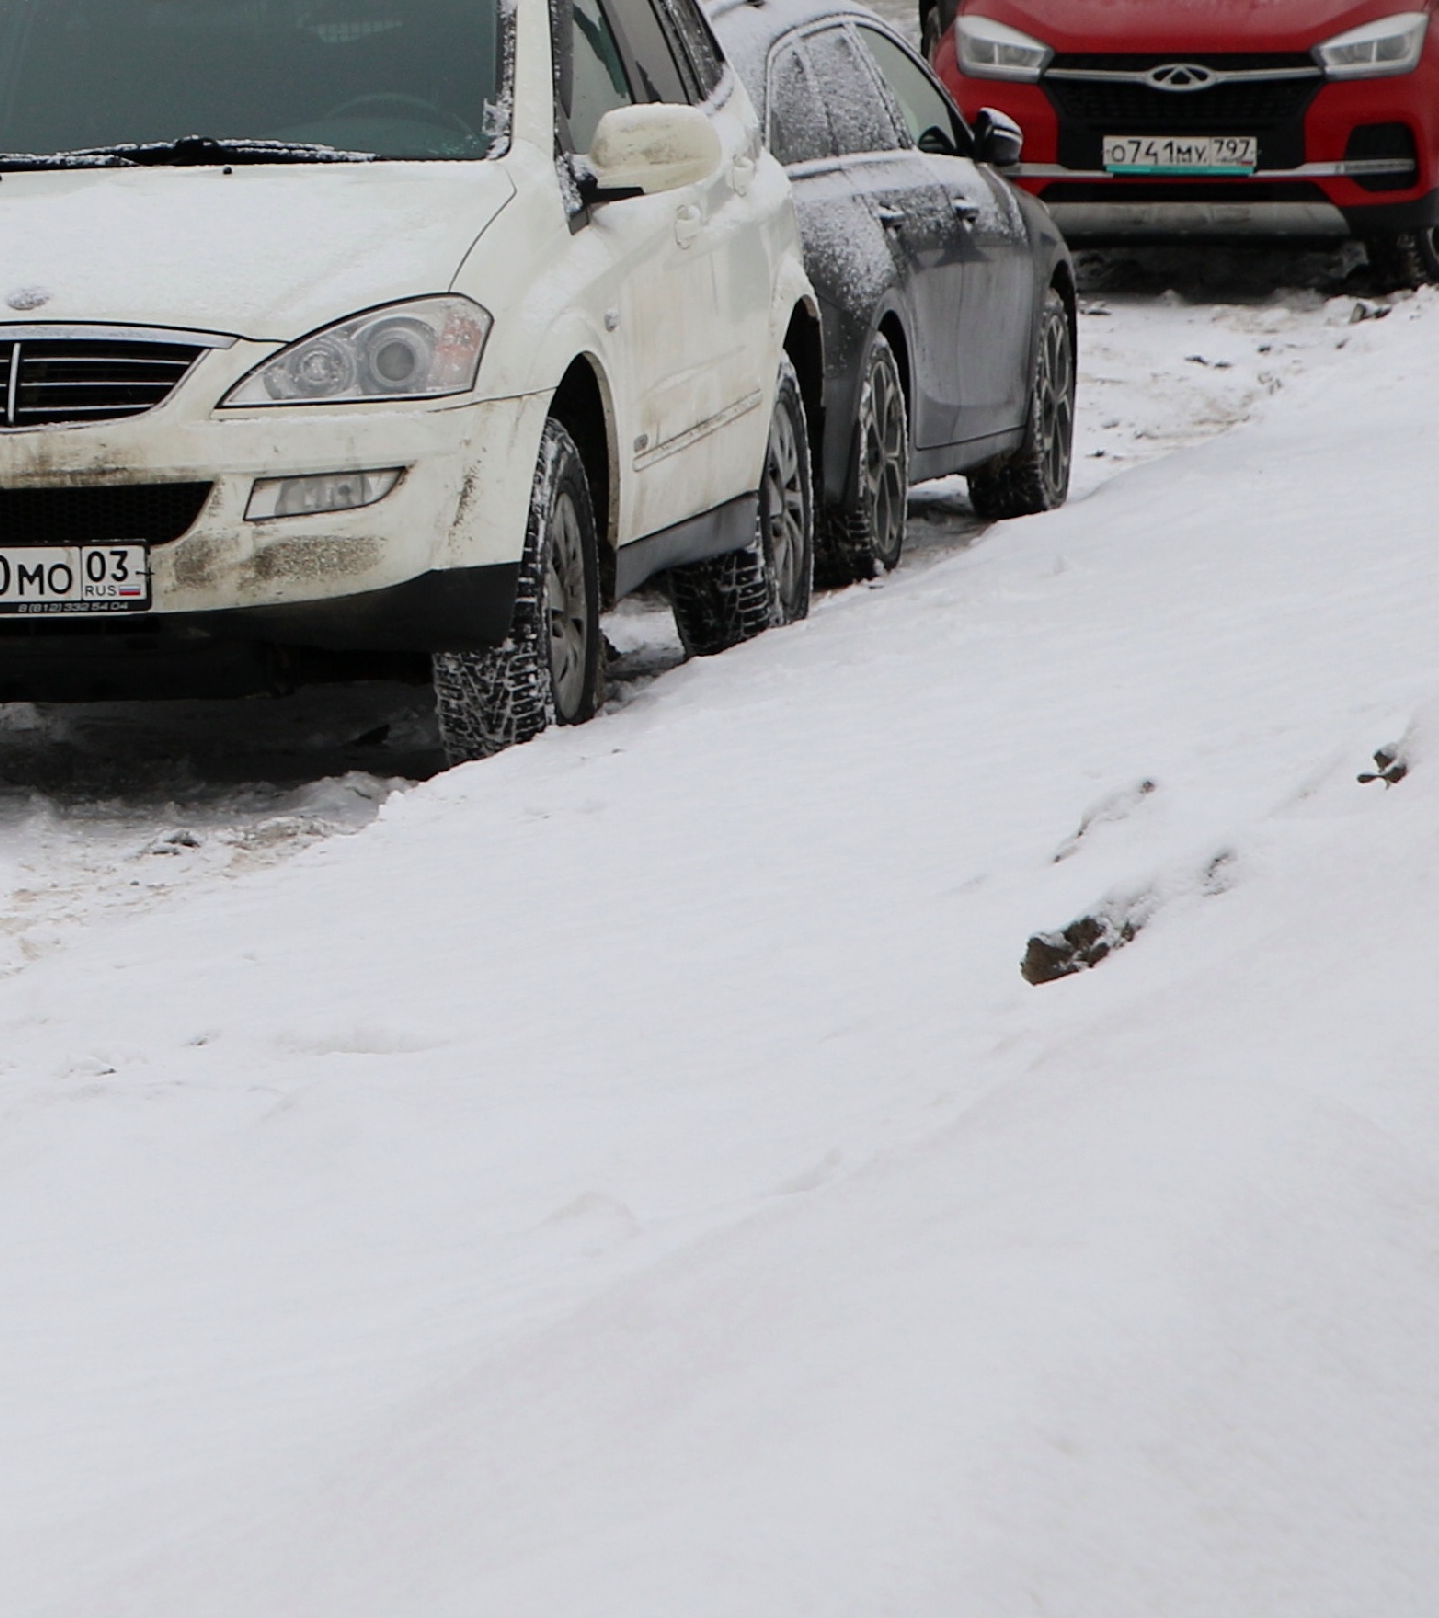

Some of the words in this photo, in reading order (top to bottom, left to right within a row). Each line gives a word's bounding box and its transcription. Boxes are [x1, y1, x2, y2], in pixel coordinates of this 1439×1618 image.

[1213, 139, 1251, 156] 797
[86, 550, 130, 583] 03
[85, 584, 118, 597] RUS
[63, 602, 89, 612] 332
[91, 601, 108, 611] 54
[110, 601, 129, 611] 04
